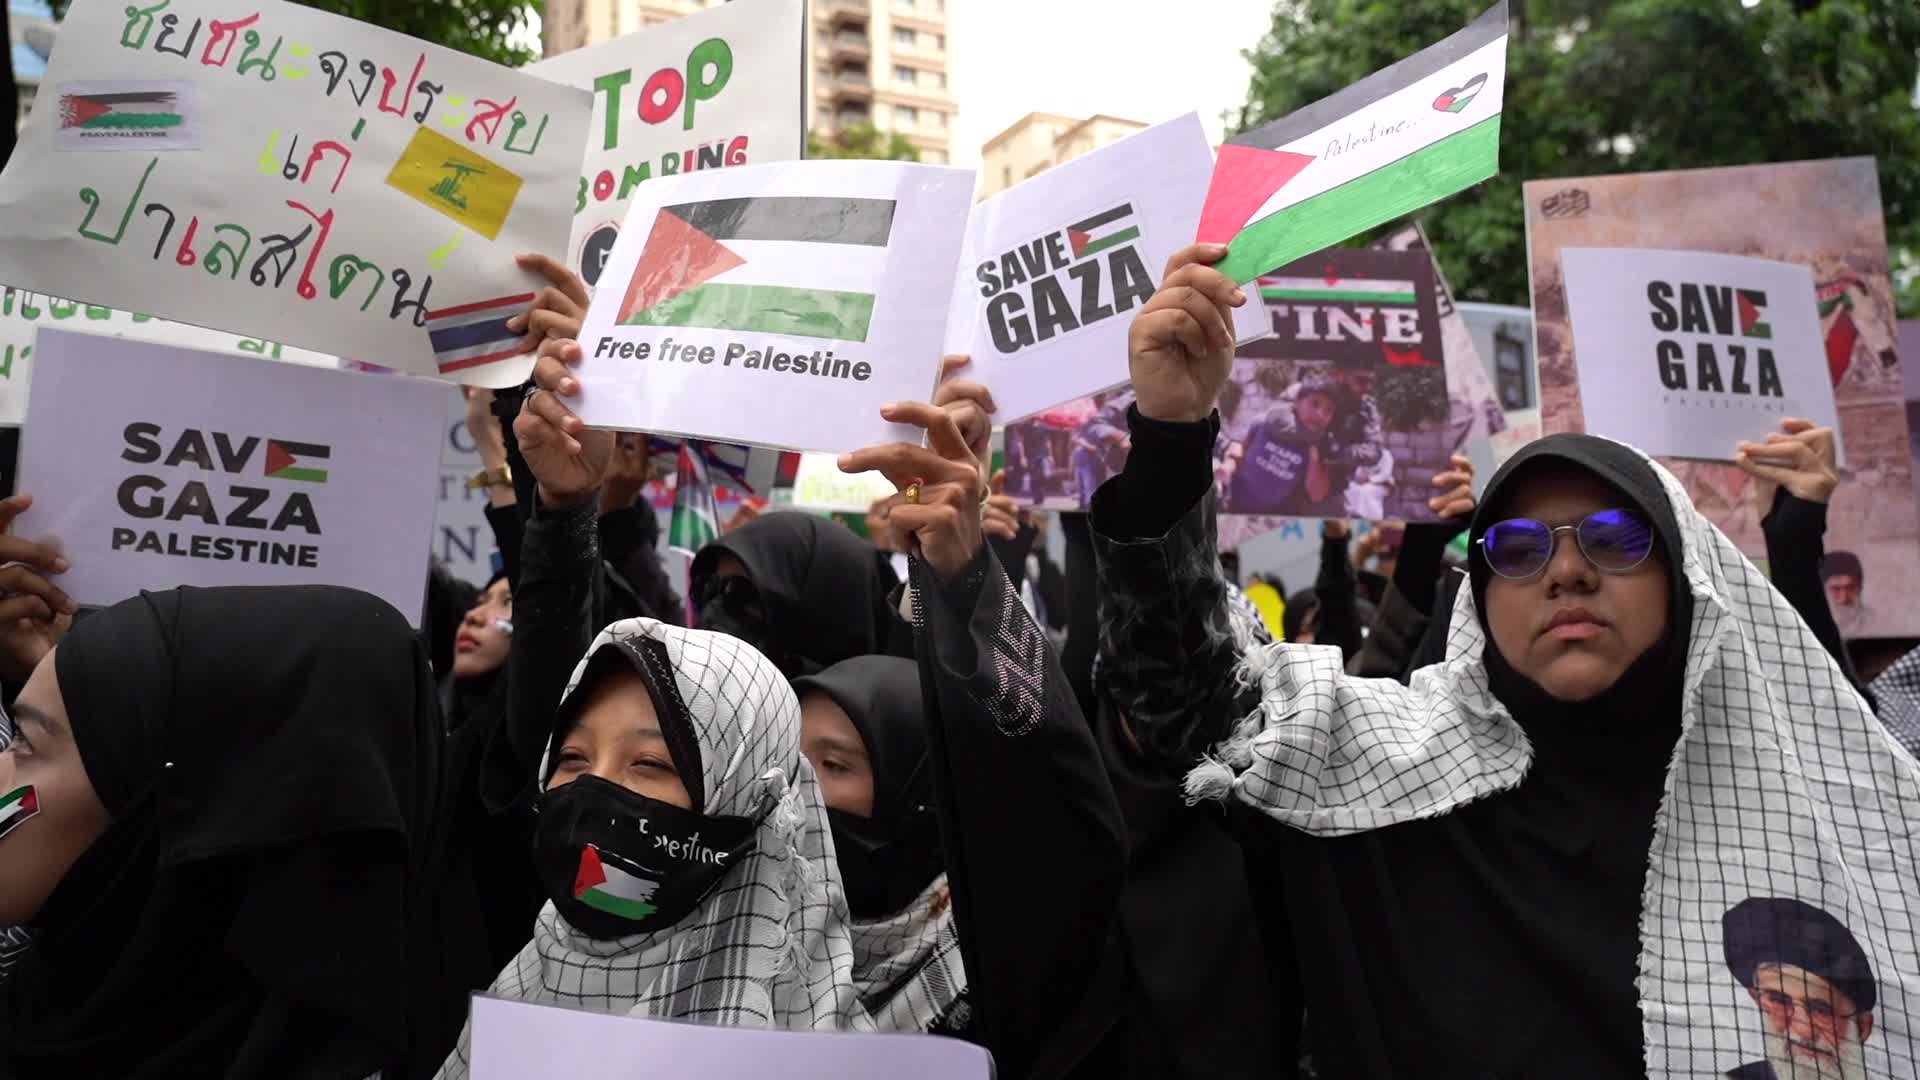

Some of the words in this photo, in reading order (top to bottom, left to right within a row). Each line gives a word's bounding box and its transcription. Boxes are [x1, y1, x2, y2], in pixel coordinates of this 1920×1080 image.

[259, 118, 368, 194] แก่
[78, 157, 466, 328] ปาเลสไตน์
[976, 231, 1070, 298] SAVE
[986, 245, 1157, 353] GAZA
[595, 336, 651, 360] Free
[658, 337, 715, 365] free
[723, 342, 872, 382] Palestine
[1656, 339, 1784, 398] GAZA
[117, 474, 322, 535] GAZA
[111, 527, 319, 568] PALESTINE
